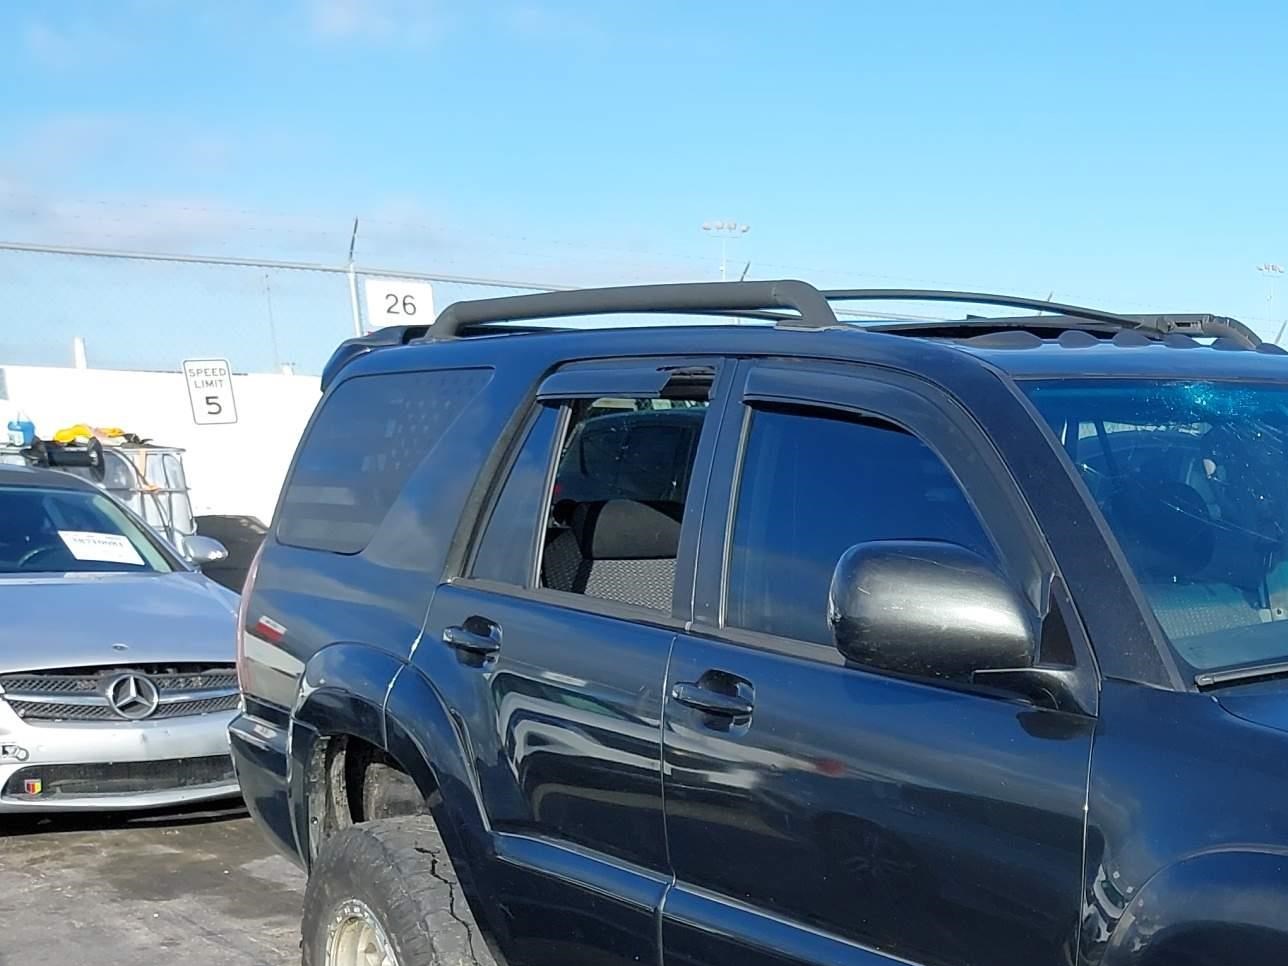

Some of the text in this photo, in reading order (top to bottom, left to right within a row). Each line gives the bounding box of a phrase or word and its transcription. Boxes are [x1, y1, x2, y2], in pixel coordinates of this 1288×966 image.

[385, 293, 417, 316] 26
[188, 367, 227, 377] SPEED
[194, 379, 224, 389] LIMIT
[205, 395, 223, 415] 5
